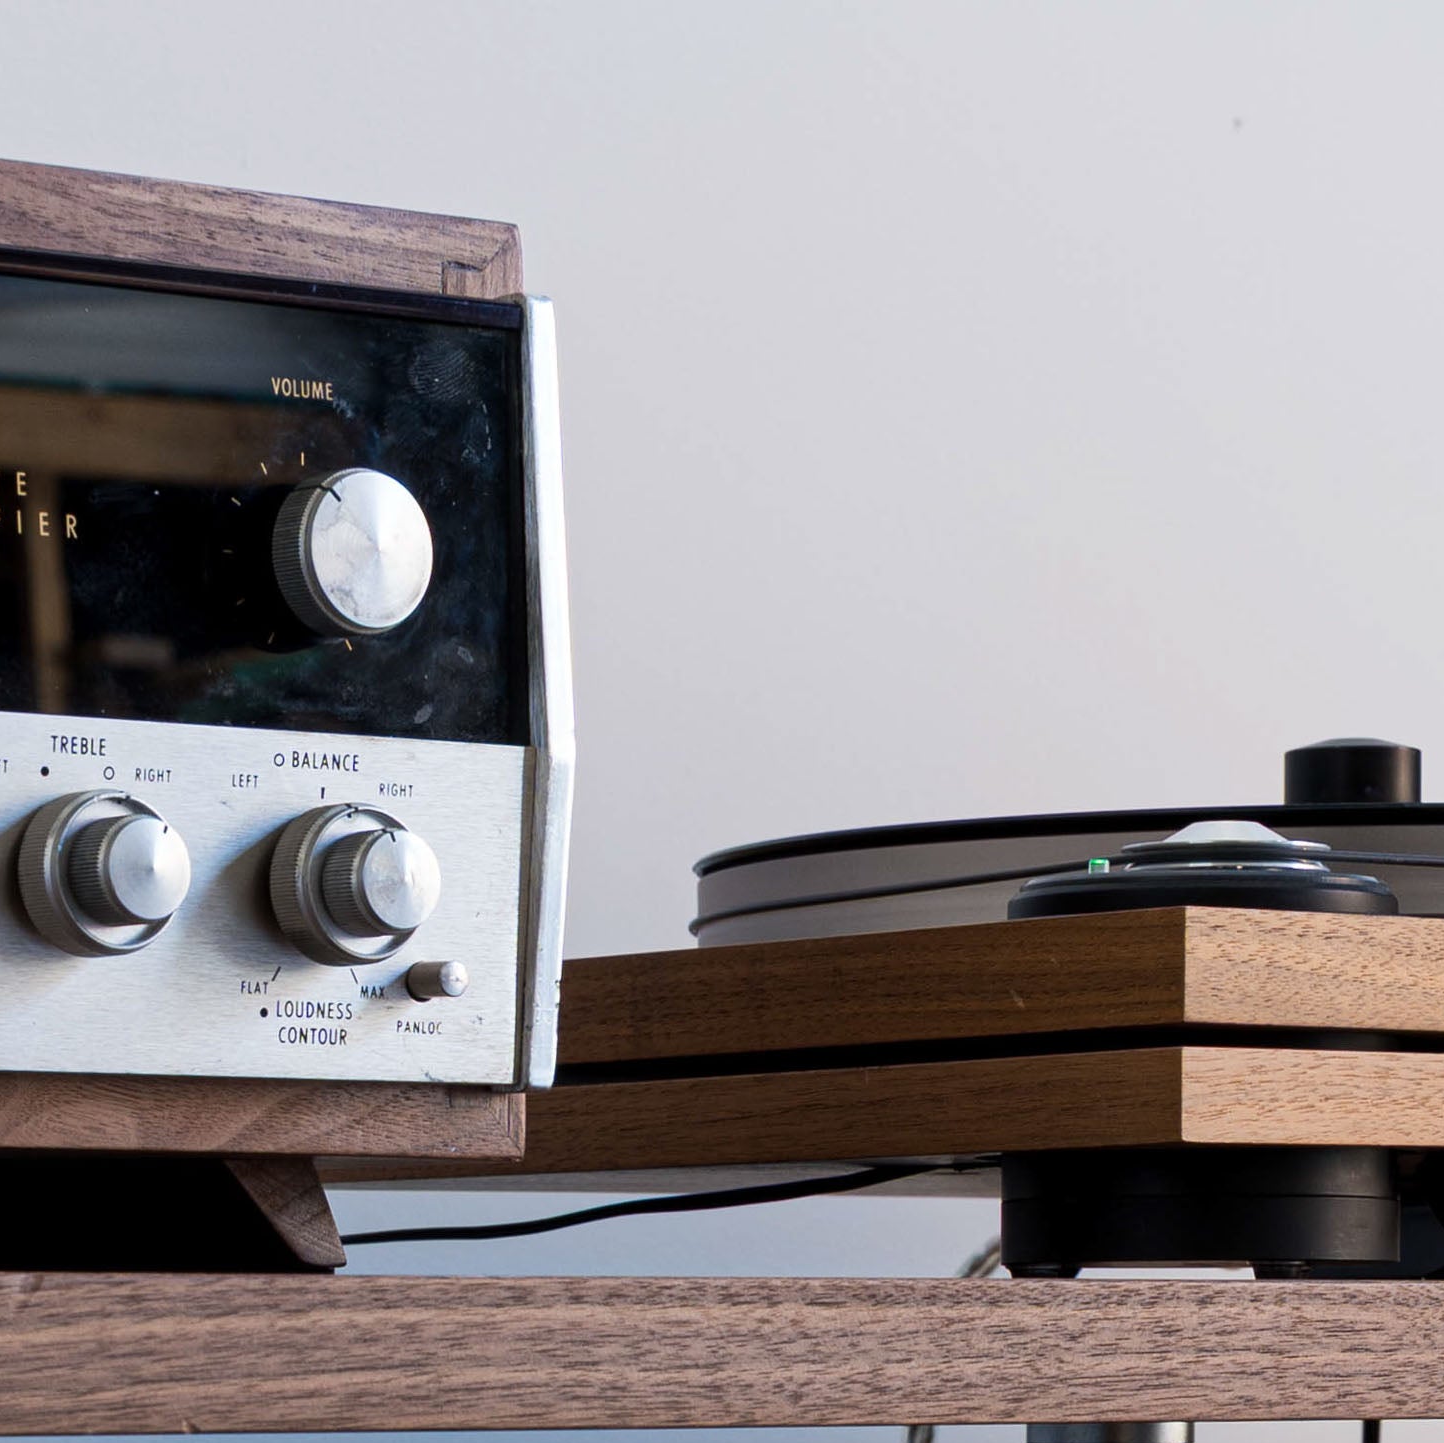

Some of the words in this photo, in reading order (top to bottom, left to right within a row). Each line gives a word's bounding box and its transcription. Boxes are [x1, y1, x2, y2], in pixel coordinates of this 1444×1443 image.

[271, 377, 334, 400] VOLUME
[50, 735, 107, 757] TREBLE
[291, 751, 360, 773] BALANCE
[135, 767, 172, 784] RIGHT
[231, 773, 259, 789] LEFT
[379, 783, 414, 798] RIGHT
[240, 980, 269, 995] FLAT
[276, 1000, 353, 1020] LOUDNESS
[278, 1027, 348, 1046] CONTOUR
[396, 1020, 443, 1035] PANLOC
